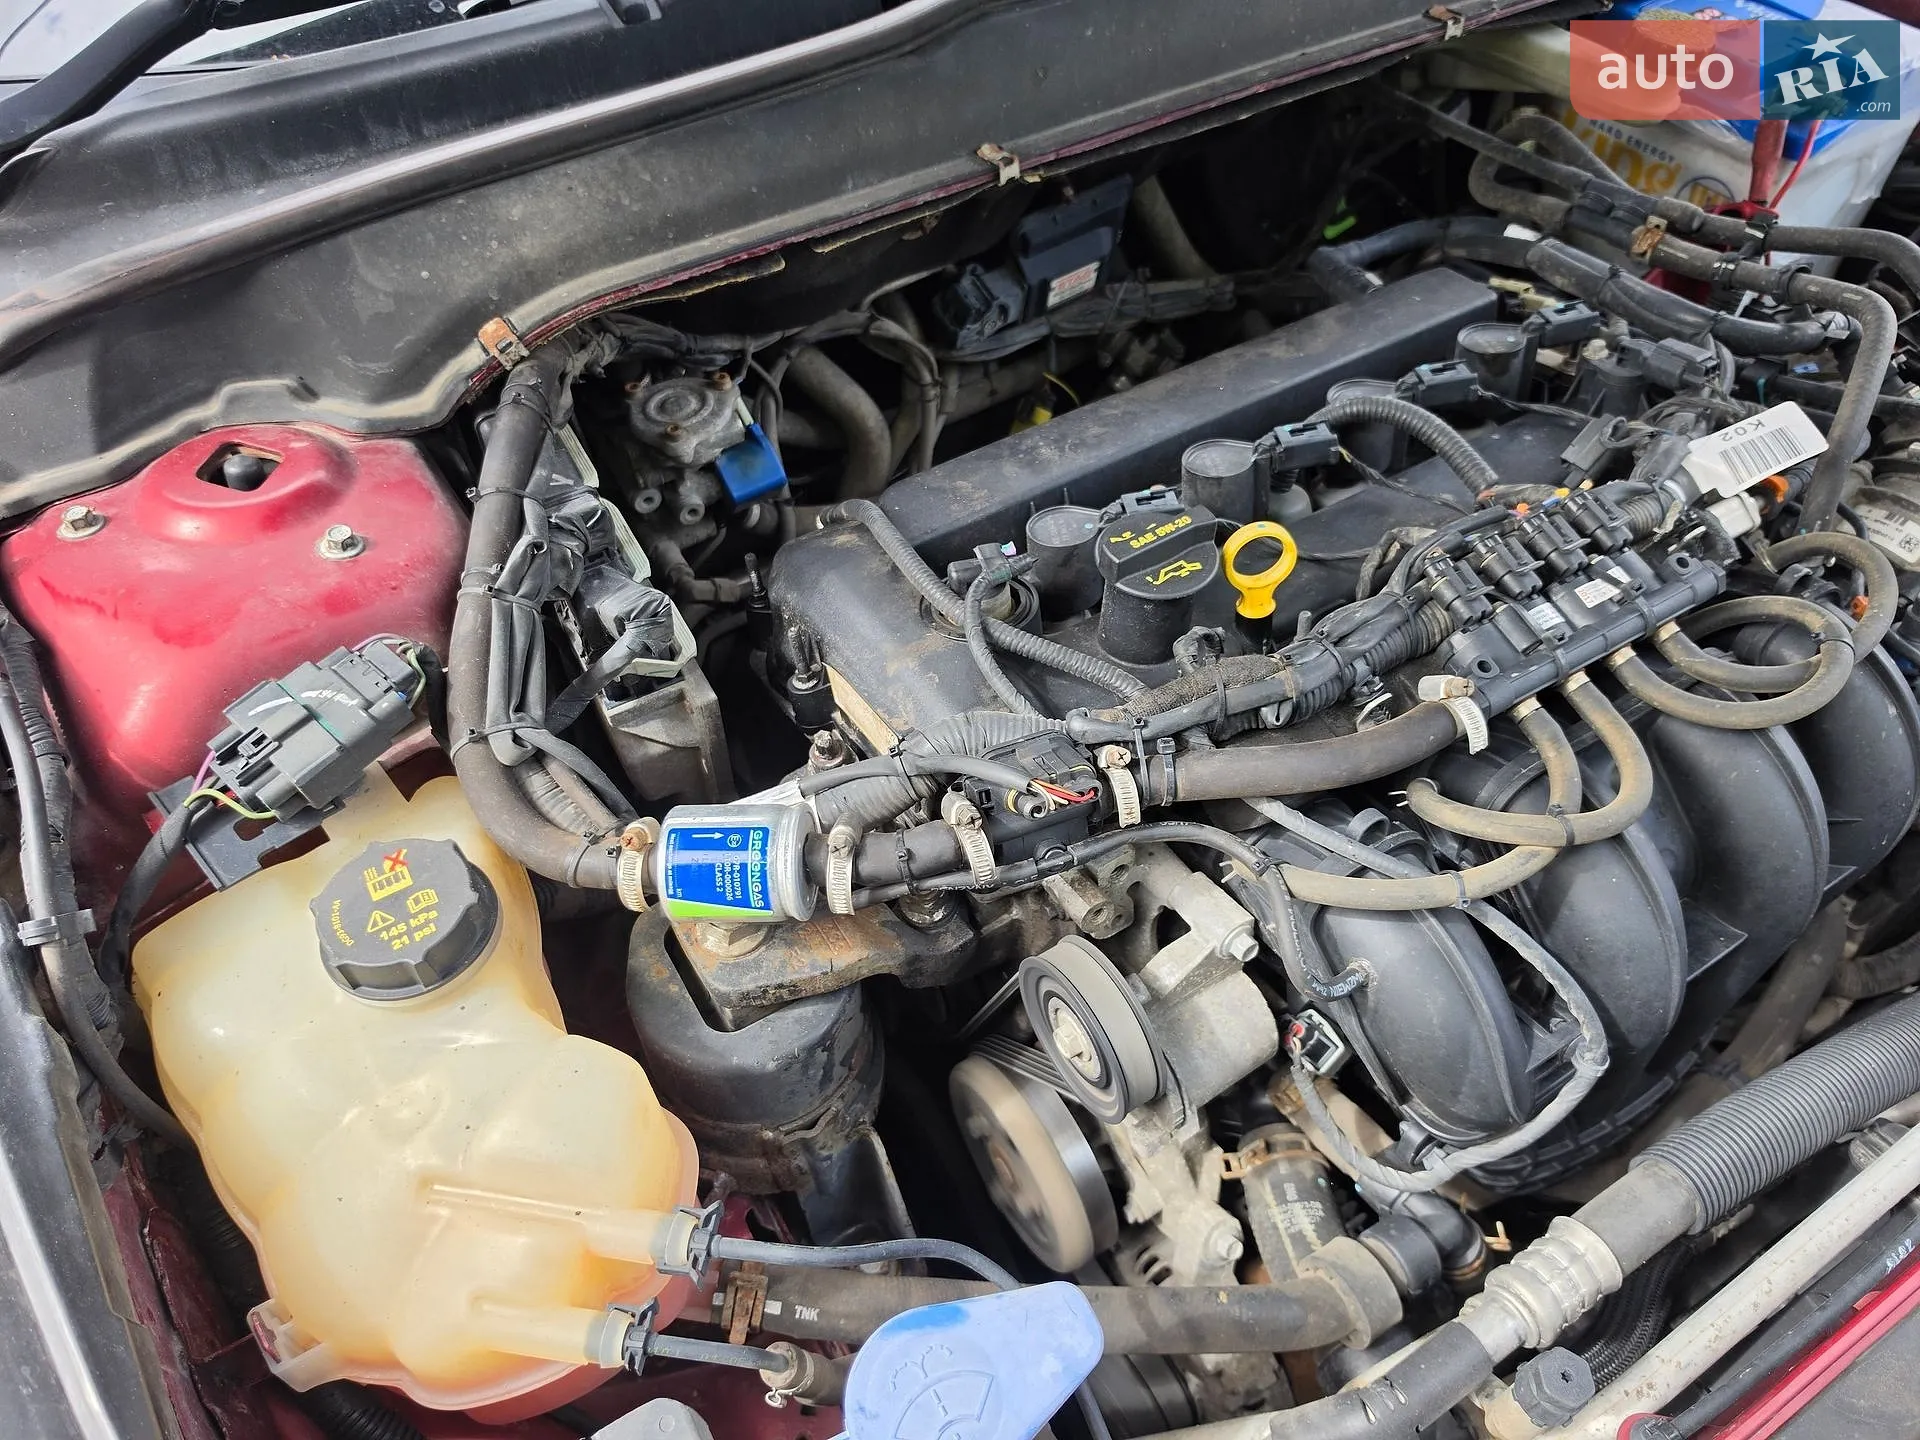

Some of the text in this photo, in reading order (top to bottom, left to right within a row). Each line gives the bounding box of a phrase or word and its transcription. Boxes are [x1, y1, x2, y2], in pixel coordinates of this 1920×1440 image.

[1626, 135, 1676, 164] ENERGY
[1719, 419, 1766, 442] K02
[1129, 515, 1193, 549] SAE 5W-20
[715, 863, 723, 887] CLASS
[379, 910, 439, 941] 145 kPa
[391, 922, 437, 951] 21 psi
[794, 1304, 821, 1321] TNK
